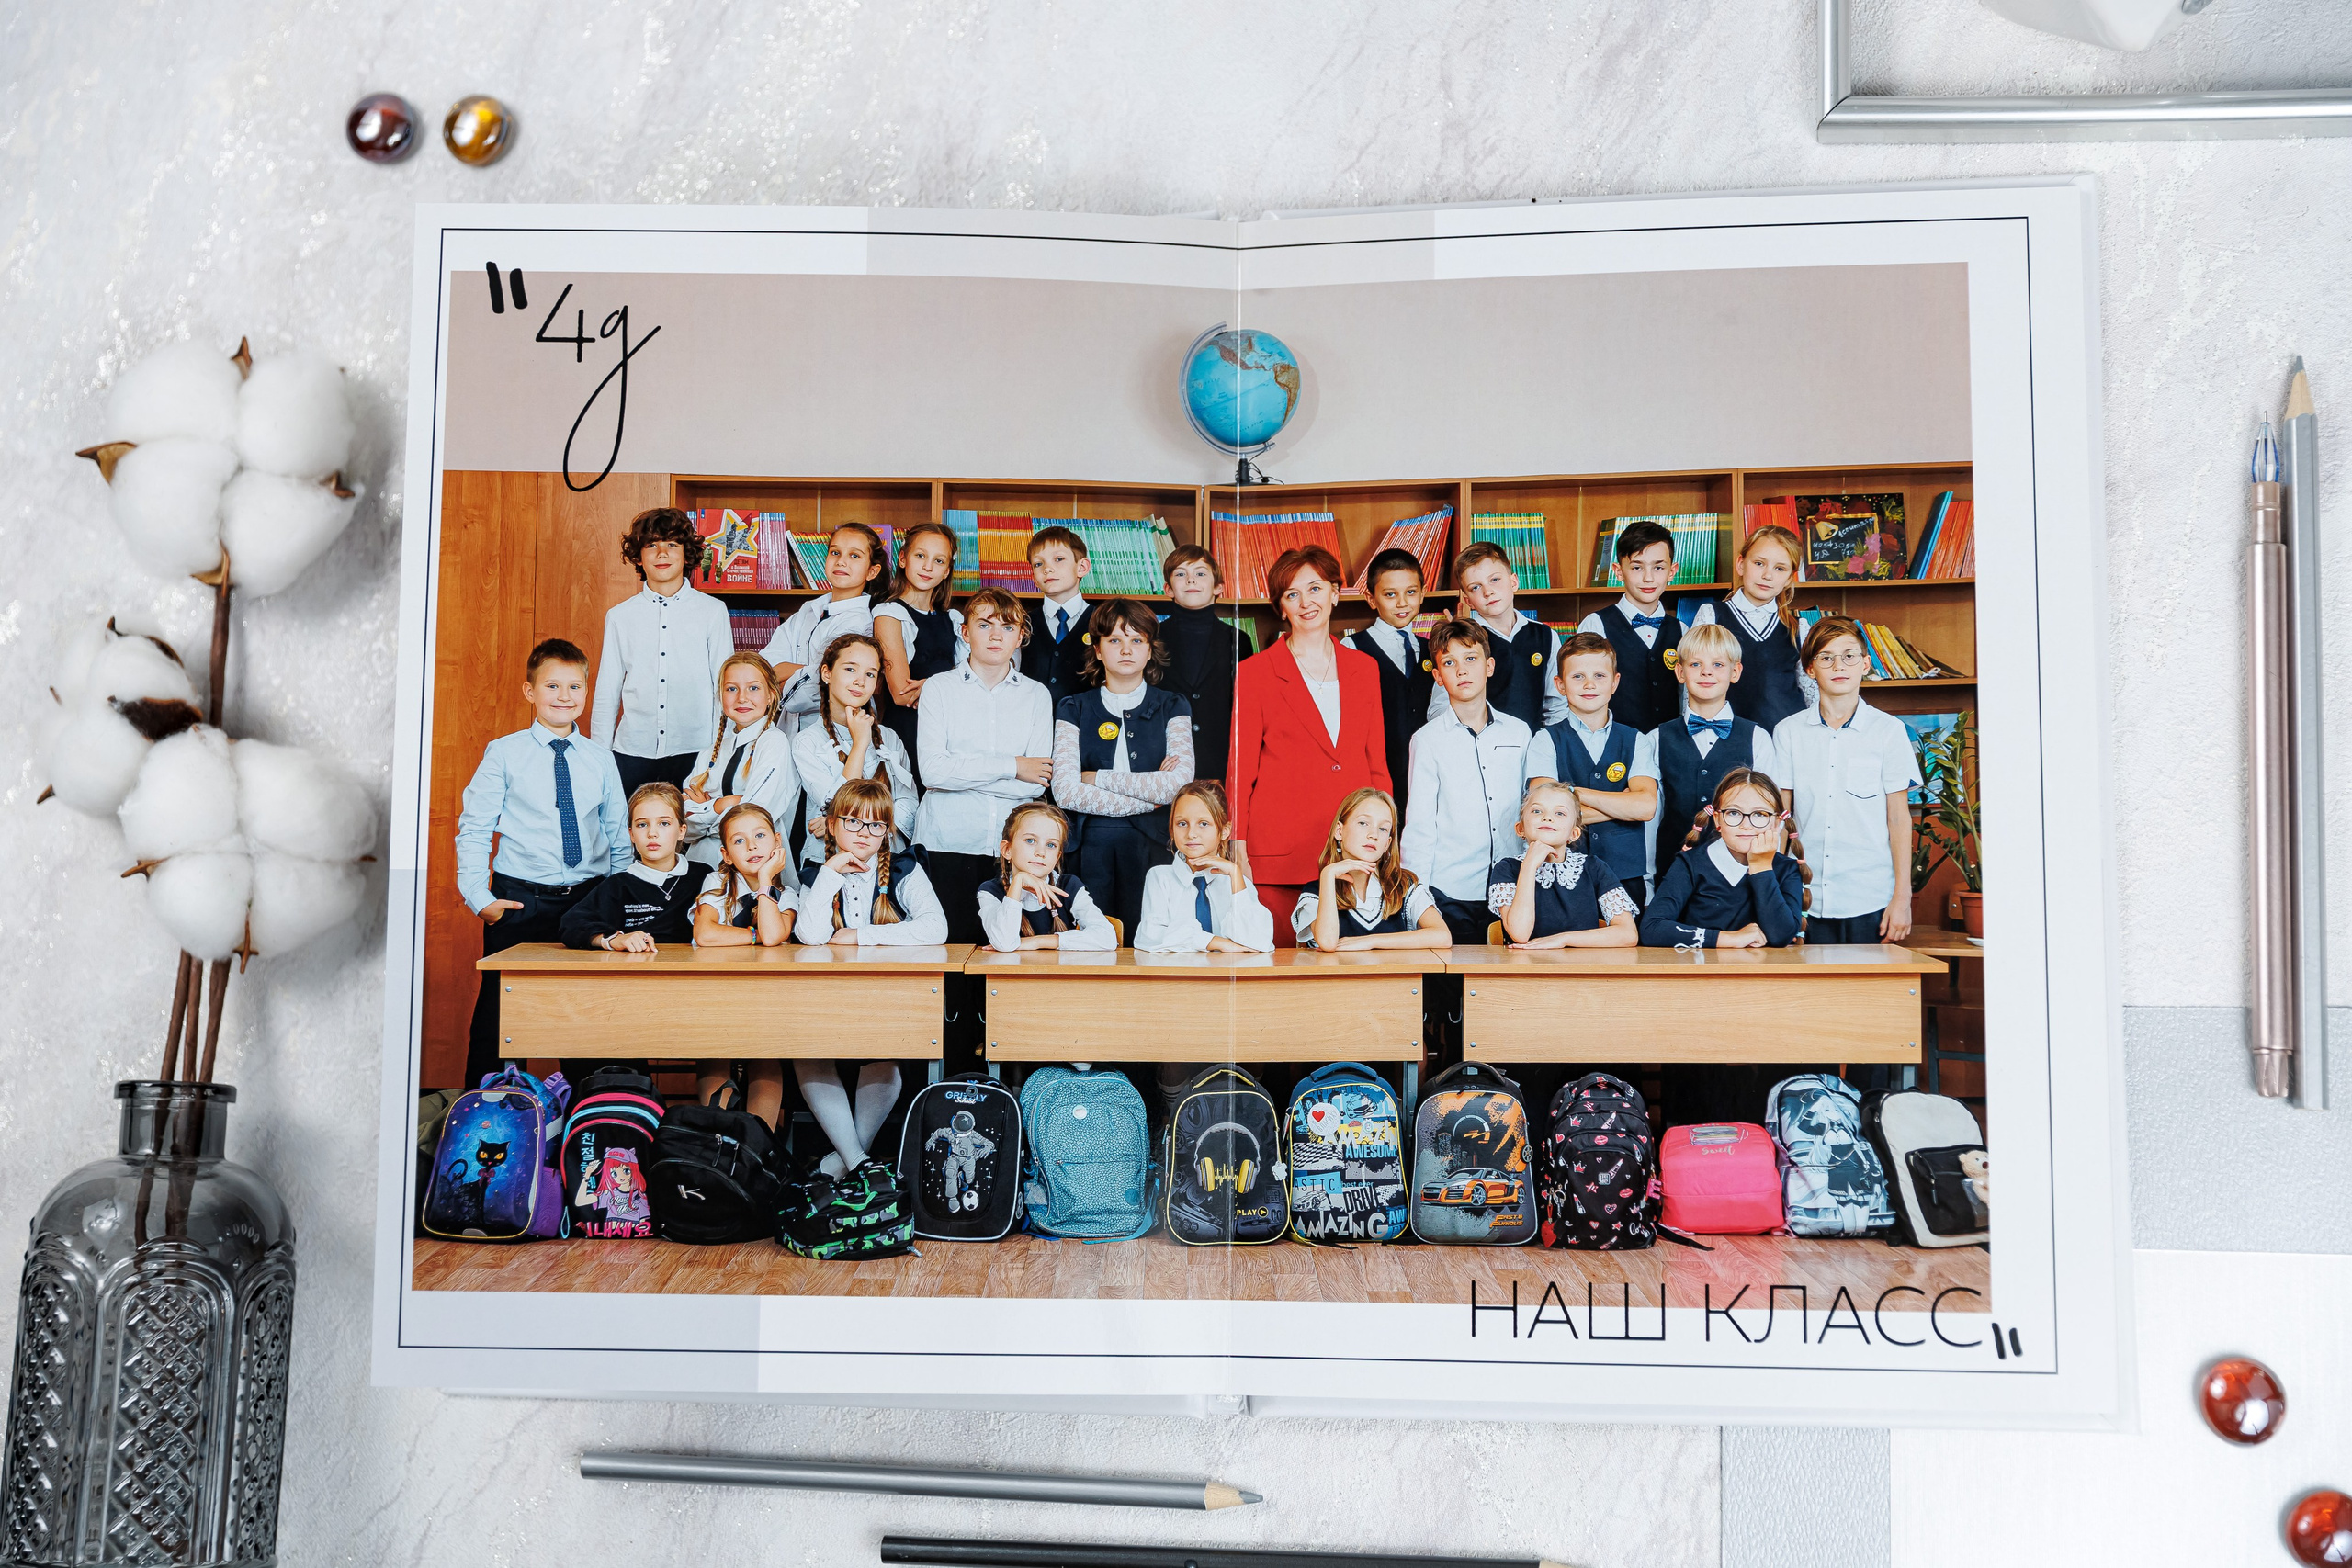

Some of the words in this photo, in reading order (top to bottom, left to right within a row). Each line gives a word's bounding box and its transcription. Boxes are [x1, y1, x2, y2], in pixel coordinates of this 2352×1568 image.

[727, 574, 752, 582] ВОЙНЕ
[1294, 1211, 1389, 1239] AMAZING
[1471, 1280, 1666, 1342] НАШ
